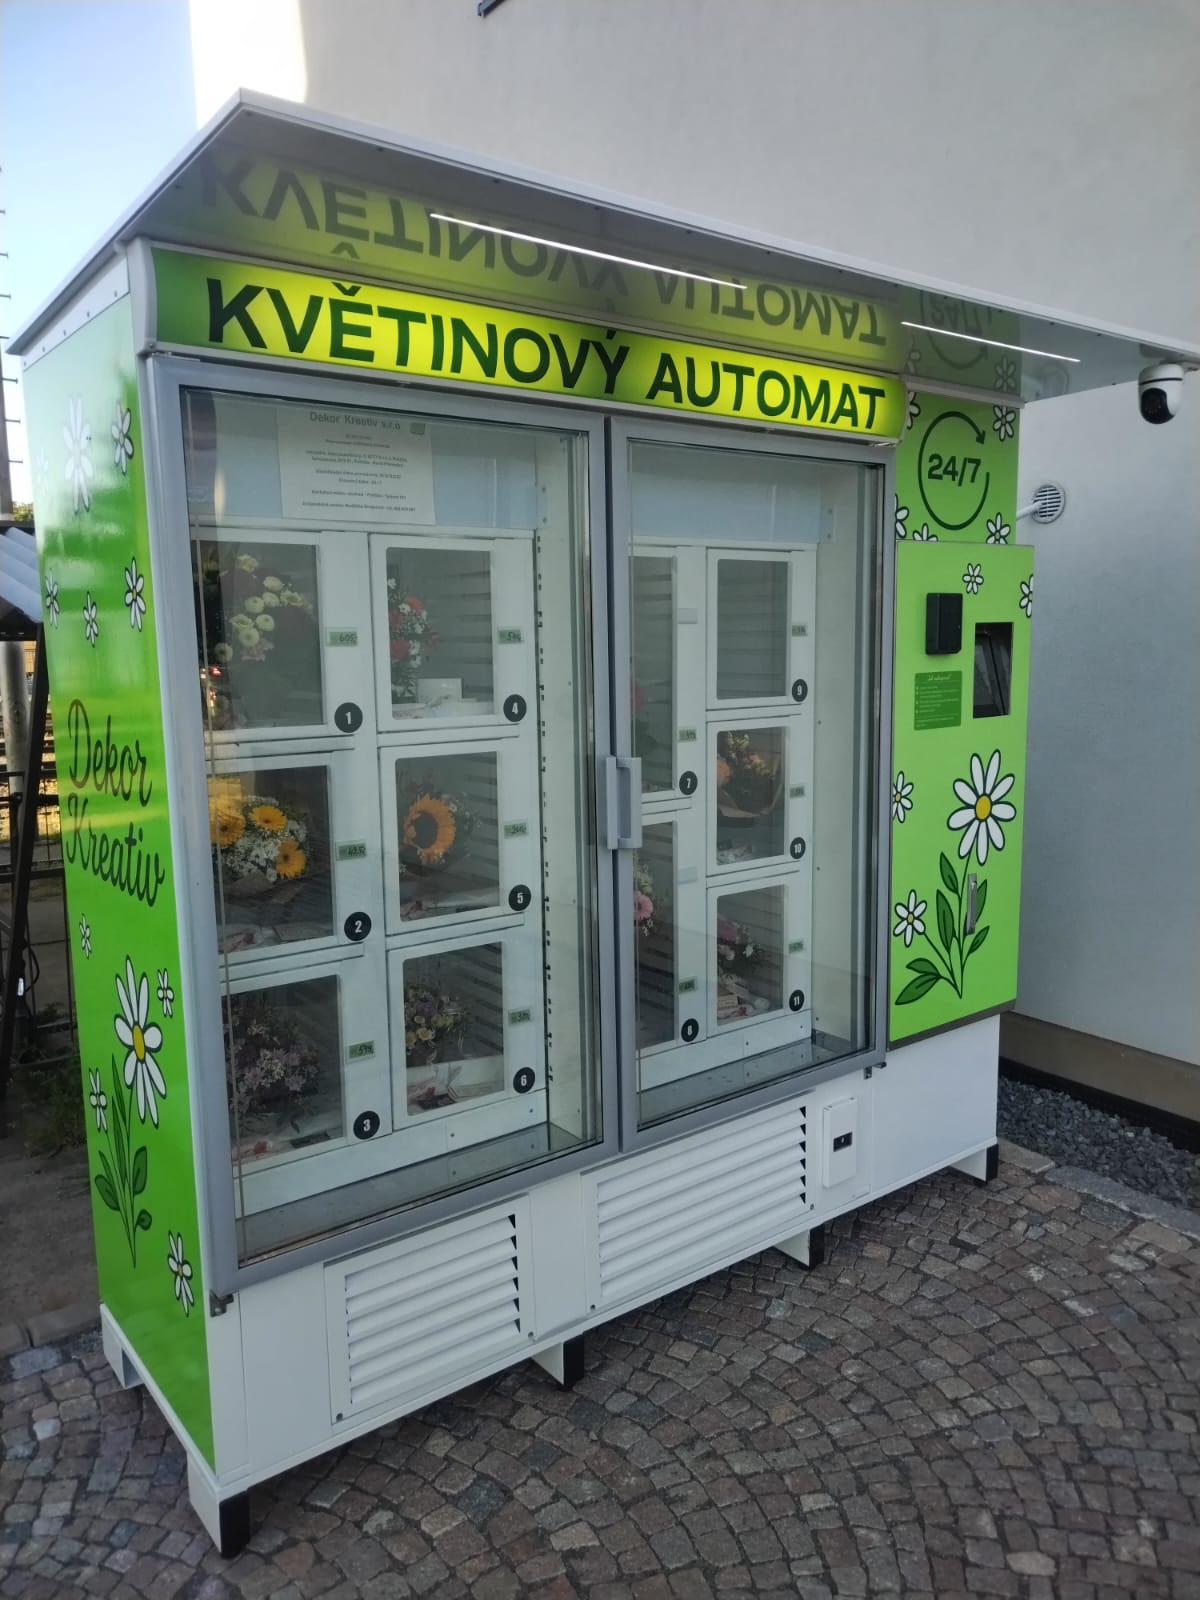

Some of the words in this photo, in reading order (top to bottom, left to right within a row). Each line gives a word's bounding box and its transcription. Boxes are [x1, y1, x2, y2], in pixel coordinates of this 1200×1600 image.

[206, 277, 630, 394] KVĚTINOVÝ
[646, 352, 886, 430] AUTOMAT
[309, 411, 340, 424] Dekor
[927, 453, 982, 487] 24/7
[511, 702, 519, 715] 4
[345, 711, 352, 725] 1
[67, 698, 153, 808] Dekor
[66, 792, 166, 908] Kreativ
[794, 842, 802, 854] 10
[516, 891, 524, 904] 5
[354, 919, 363, 933] 2
[793, 995, 800, 1007] 11
[520, 1073, 527, 1086] 6
[363, 1118, 371, 1132] 3
